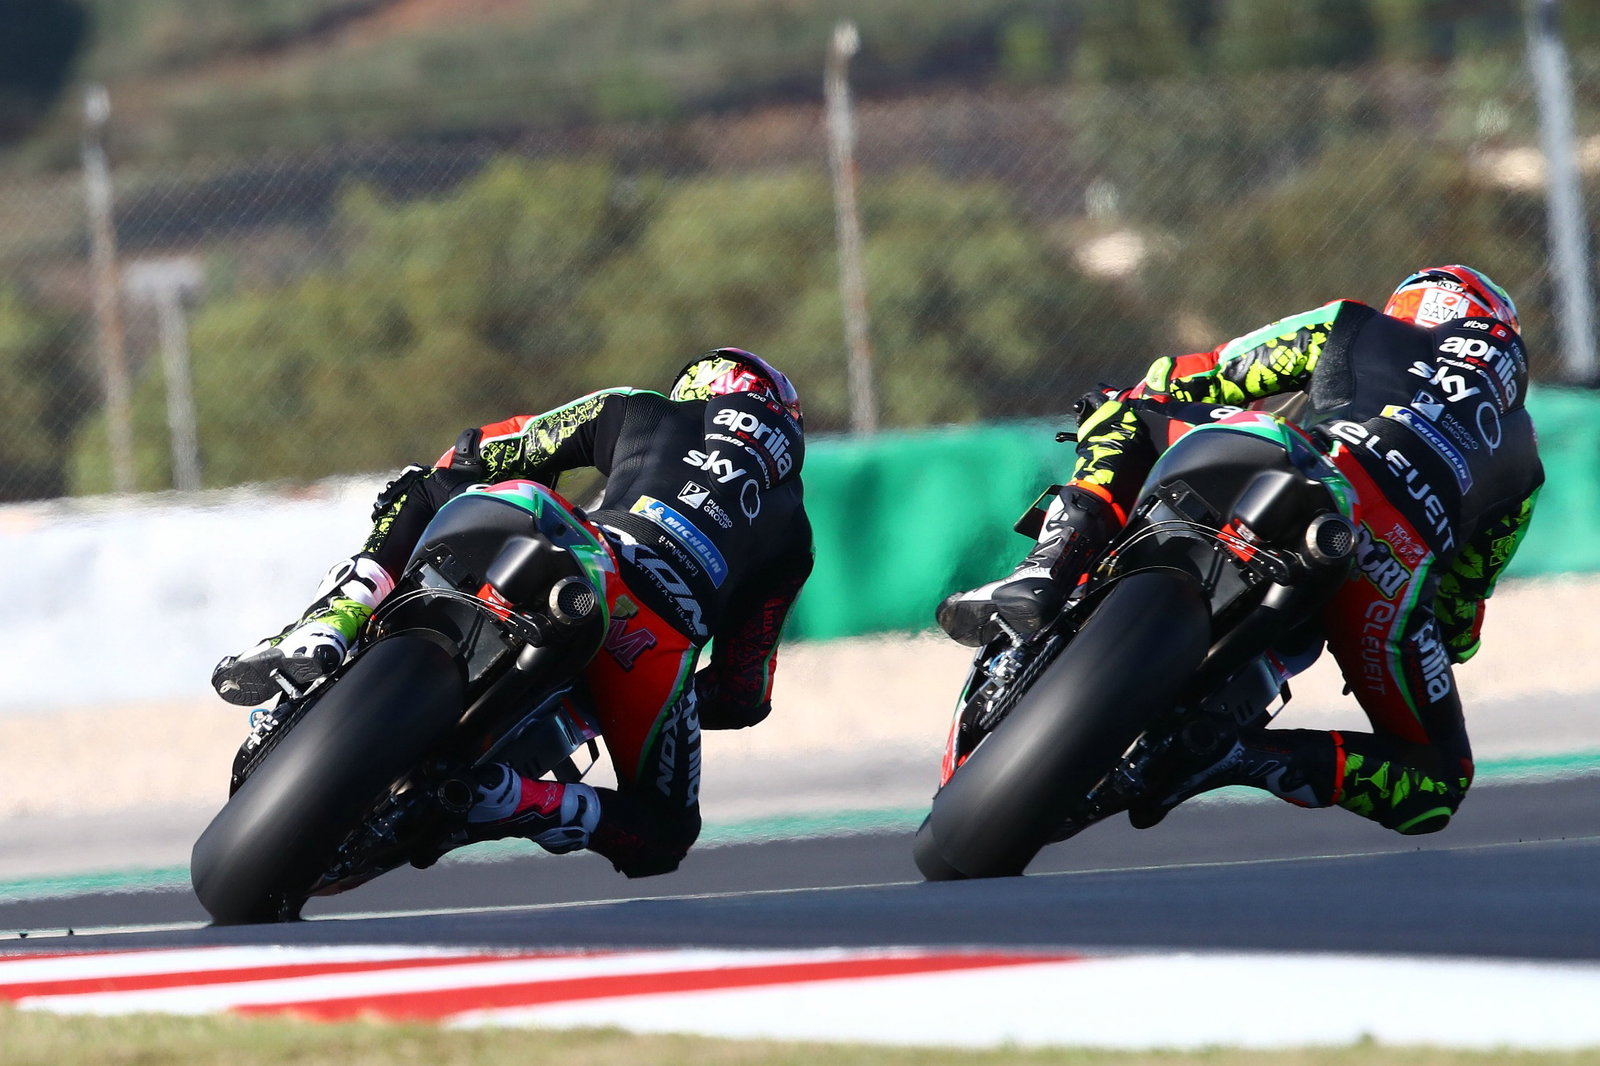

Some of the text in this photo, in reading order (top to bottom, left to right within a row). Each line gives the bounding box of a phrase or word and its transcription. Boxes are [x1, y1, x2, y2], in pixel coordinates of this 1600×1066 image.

[1408, 361, 1481, 403] sky
[1439, 336, 1518, 407] aprilia
[712, 408, 793, 481] aprilia
[1414, 421, 1468, 480] MICHELIN
[1441, 420, 1472, 451] GROUP
[1444, 412, 1479, 451] PIAGGIO
[682, 449, 747, 485] sky
[703, 505, 729, 530] GROUP
[706, 498, 734, 529] PIAGGIO
[664, 516, 723, 575] MICHELIN
